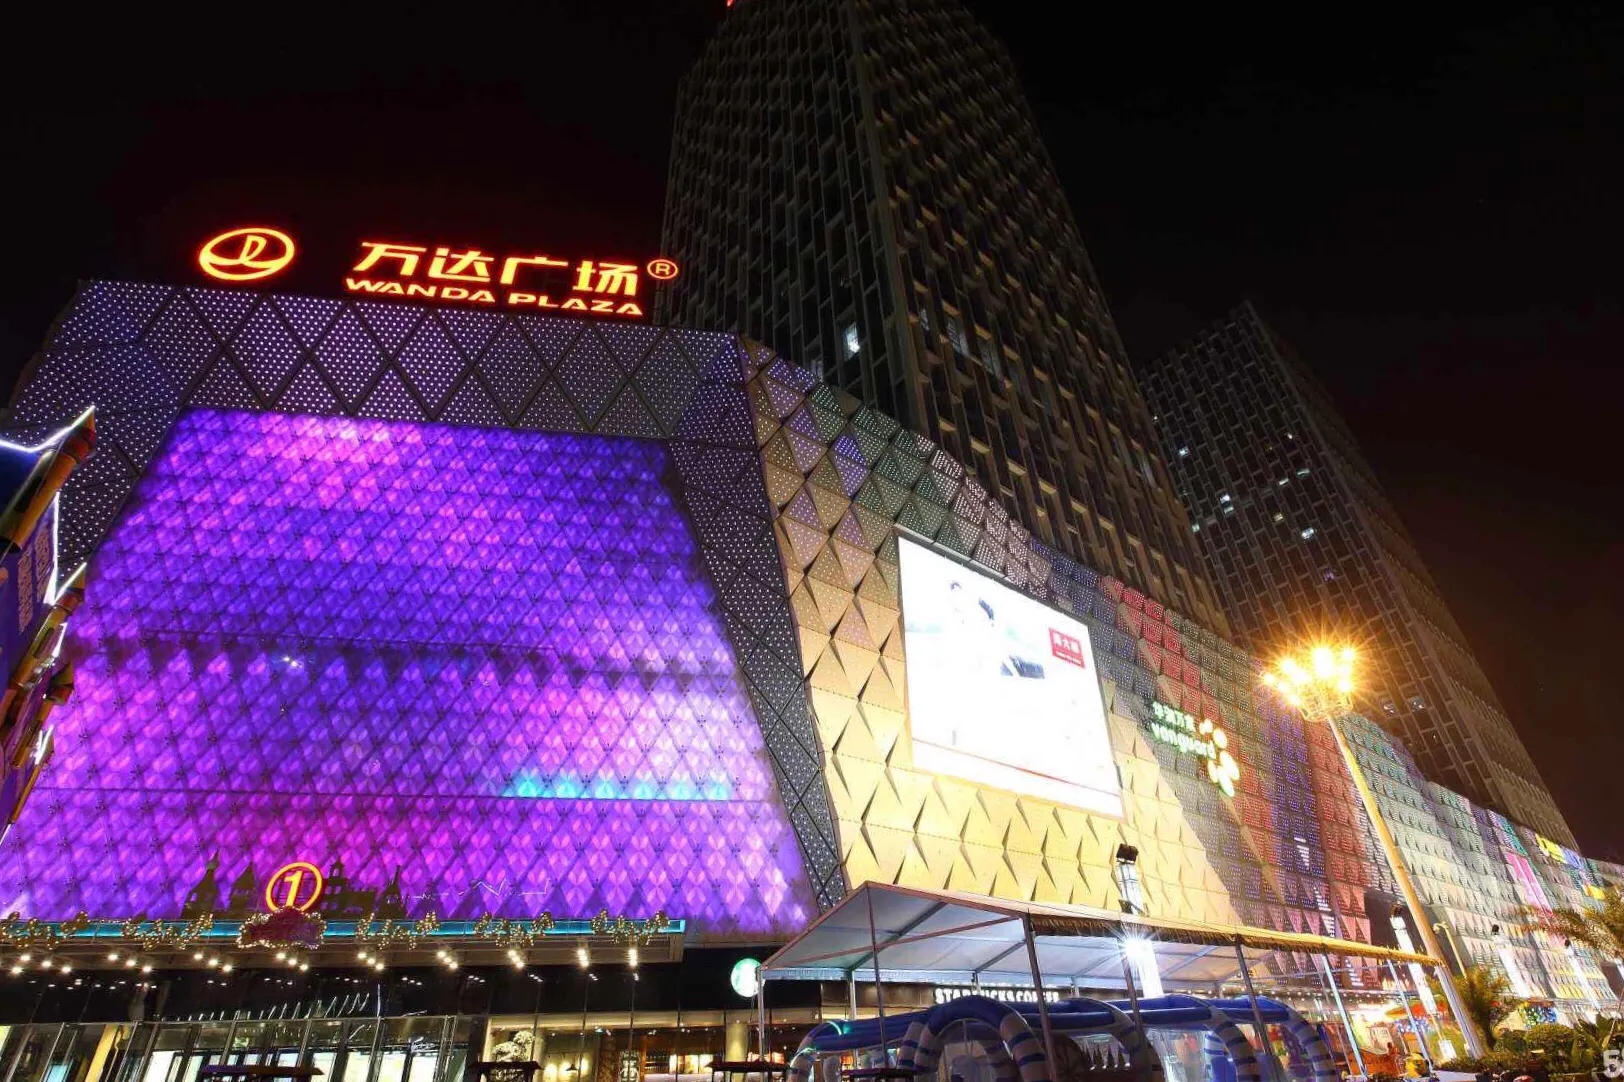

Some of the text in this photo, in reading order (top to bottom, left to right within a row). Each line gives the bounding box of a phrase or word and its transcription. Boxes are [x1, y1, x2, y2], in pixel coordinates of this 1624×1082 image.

[352, 241, 639, 297] 万达广场
[345, 278, 643, 316] WANDA PLAZA
